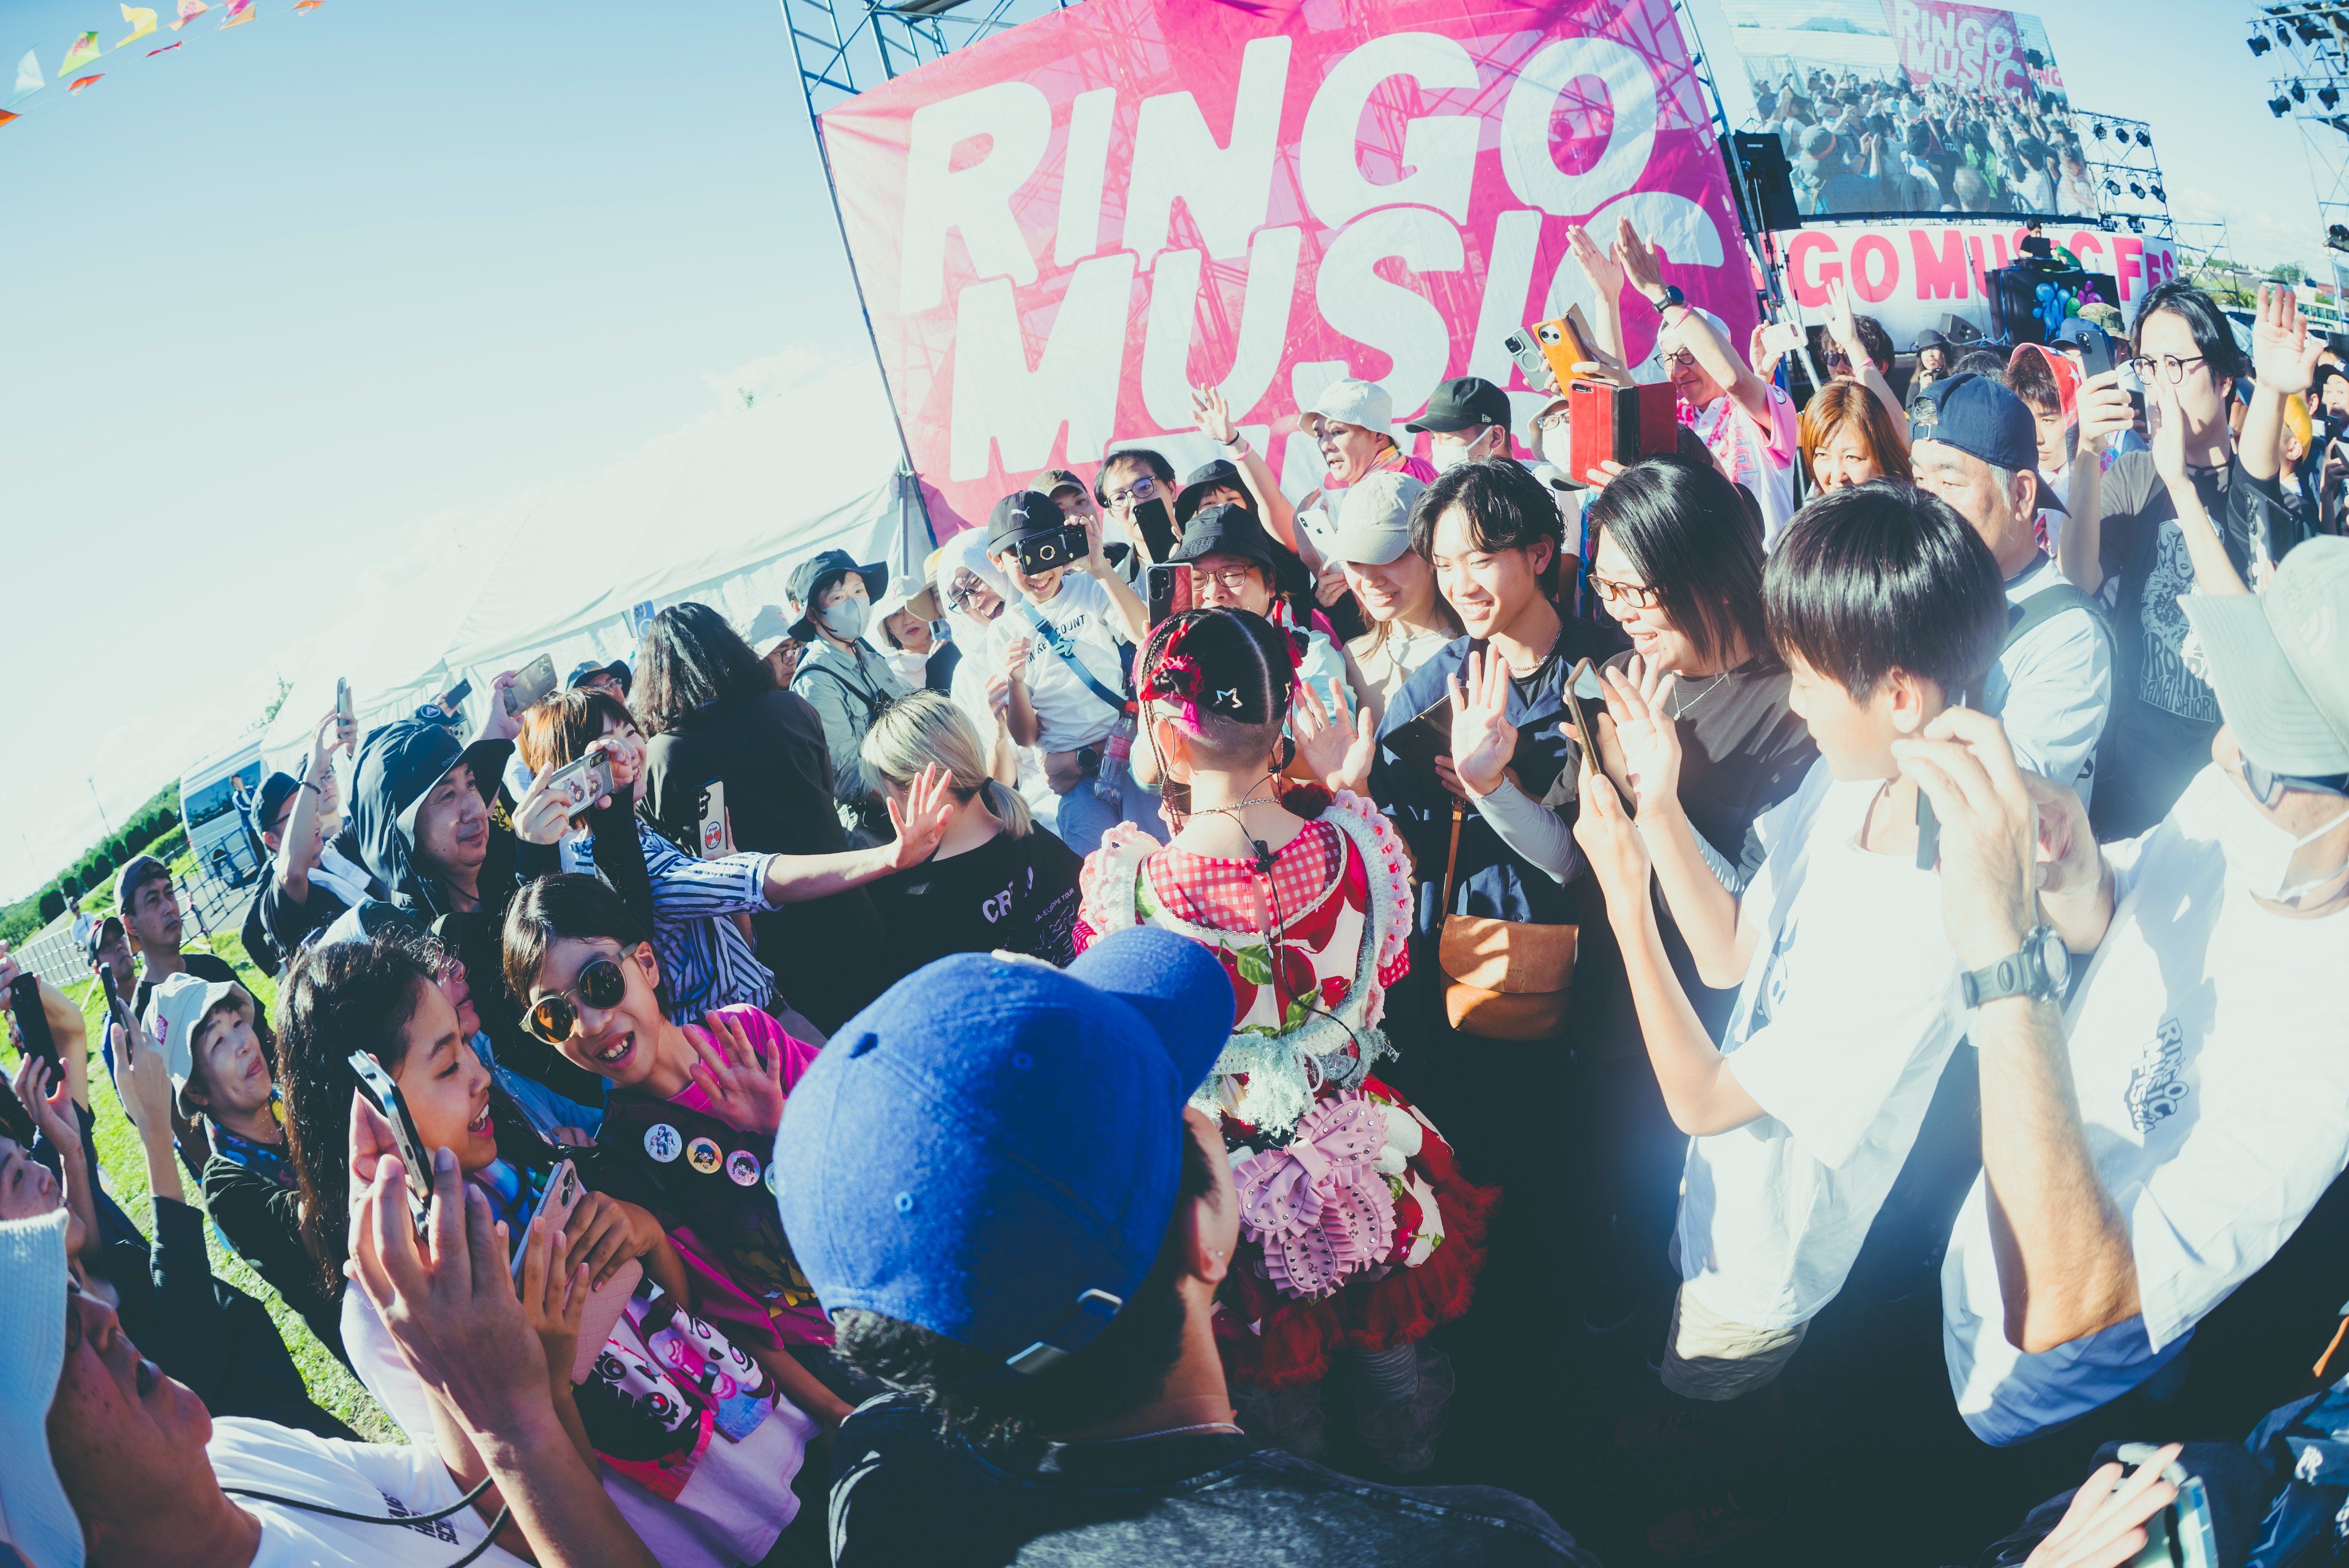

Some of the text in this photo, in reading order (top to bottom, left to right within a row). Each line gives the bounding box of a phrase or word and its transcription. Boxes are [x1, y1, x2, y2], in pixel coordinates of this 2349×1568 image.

[1894, 0, 2014, 61] RINGO
[1907, 36, 2025, 94] MUSIC
[900, 32, 1657, 315] RINGO
[950, 191, 1724, 482] MUSIC
[1055, 614, 1085, 637] COUNT
